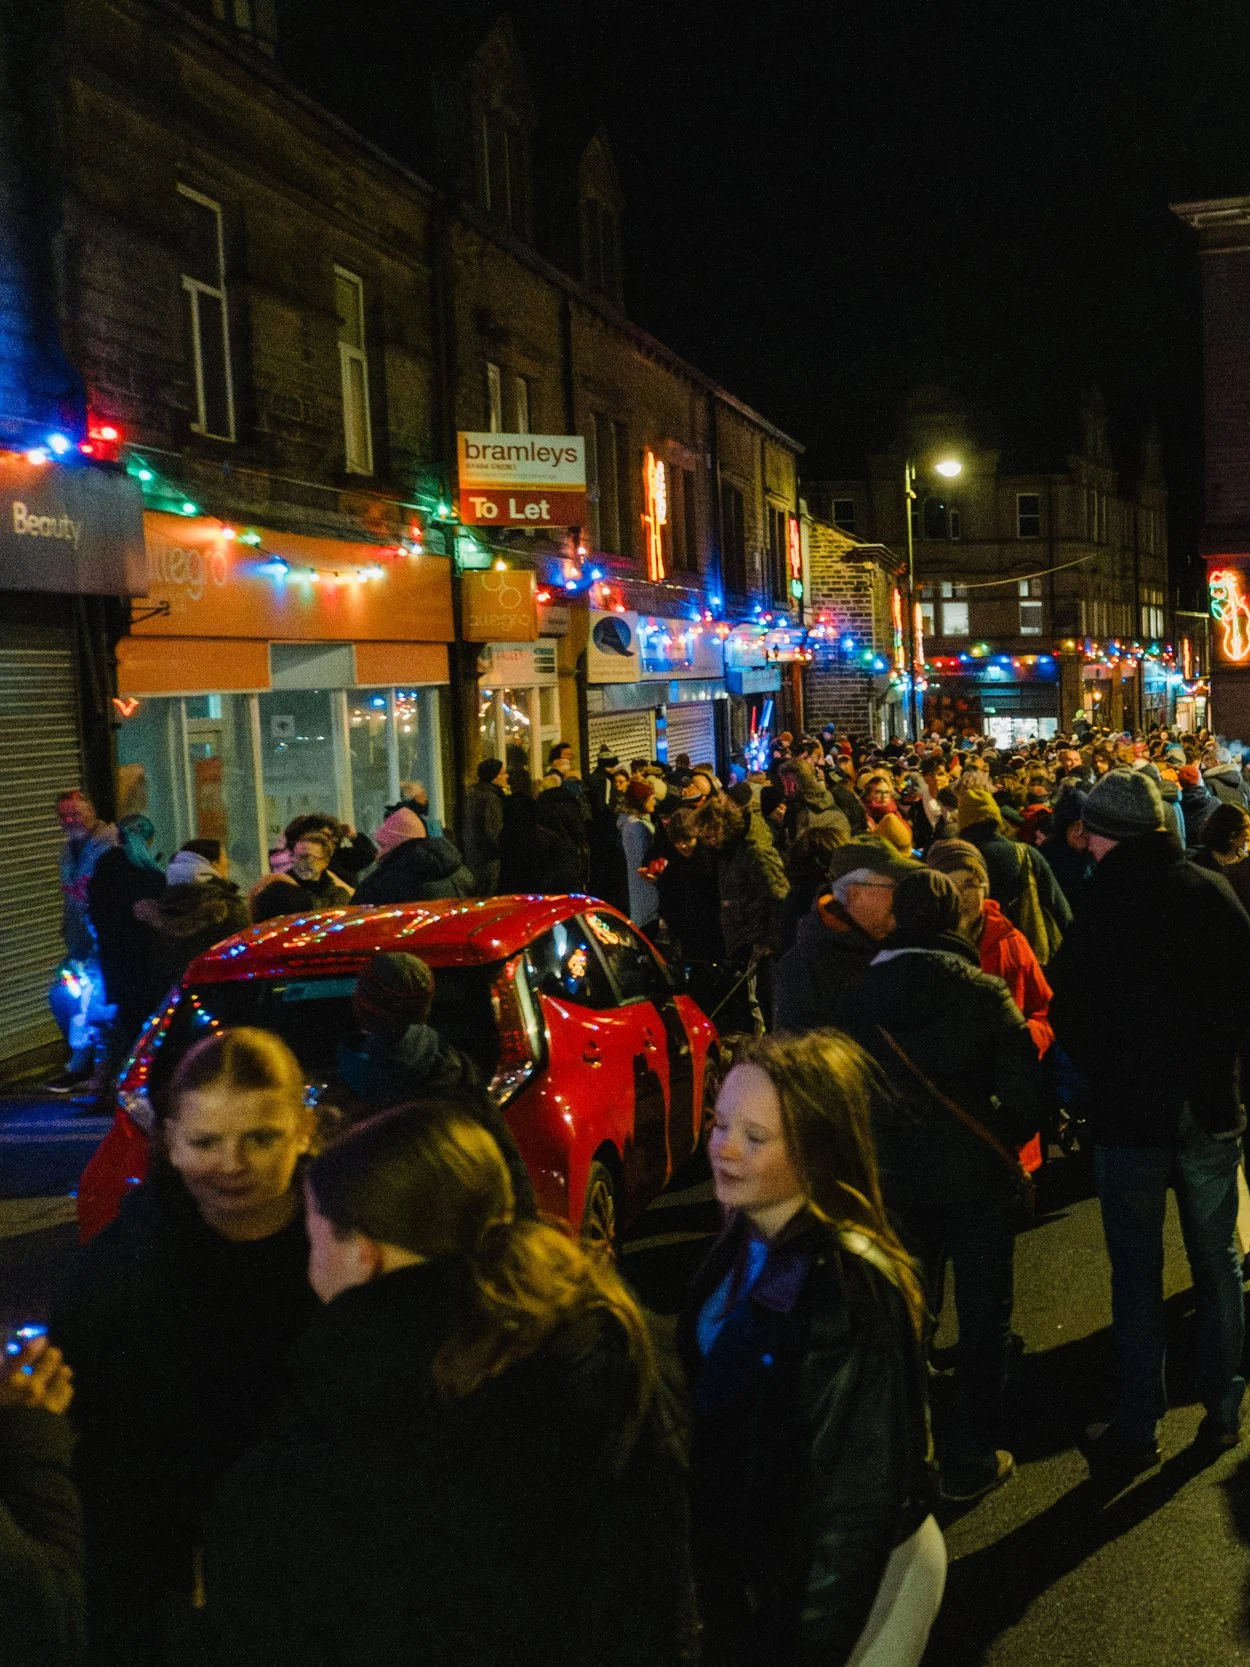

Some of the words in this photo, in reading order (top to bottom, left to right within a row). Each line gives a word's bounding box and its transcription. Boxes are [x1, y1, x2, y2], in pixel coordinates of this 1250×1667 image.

[465, 438, 578, 468] bramleys
[468, 496, 499, 520] To
[508, 497, 551, 520] Let
[12, 500, 82, 549] Beauty
